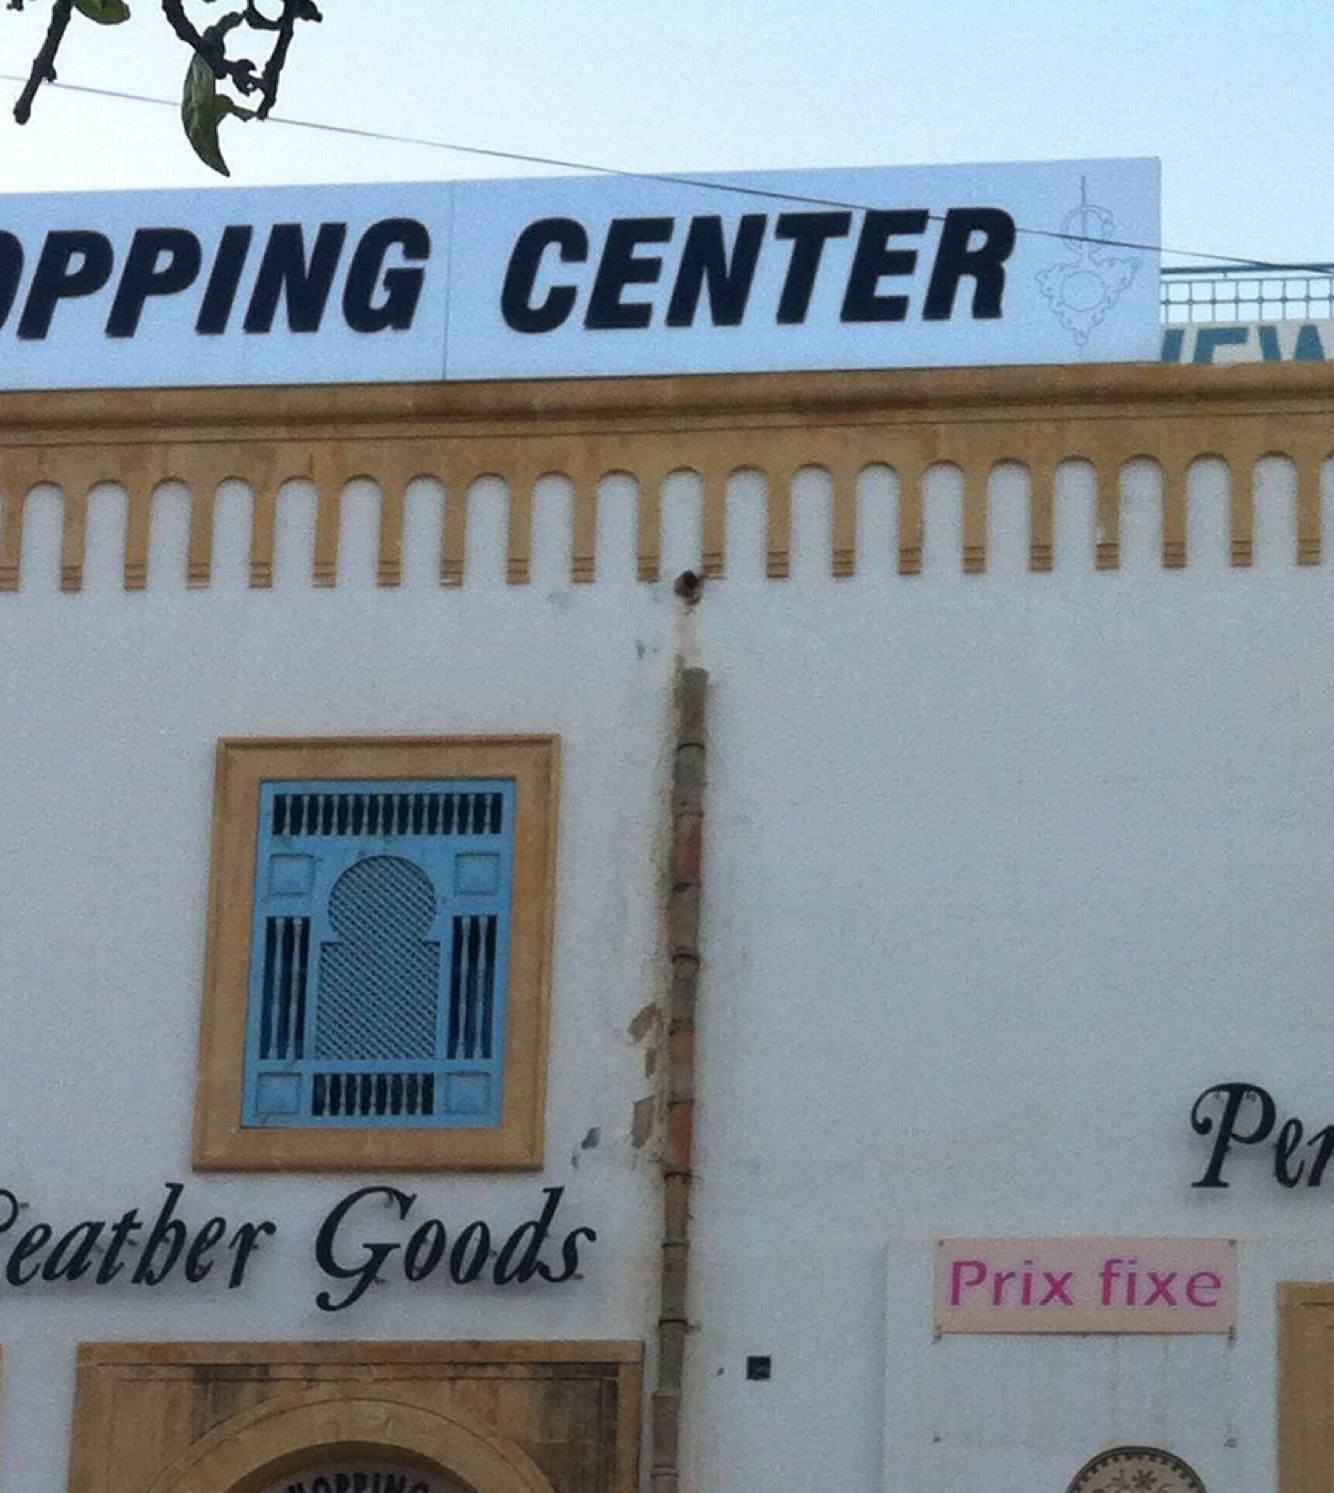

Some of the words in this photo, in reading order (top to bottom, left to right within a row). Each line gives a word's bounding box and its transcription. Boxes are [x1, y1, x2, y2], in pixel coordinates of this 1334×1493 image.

[499, 205, 1017, 336] CENTER
[314, 1185, 598, 1312] Goods
[949, 1259, 1074, 1307] Prix
[1098, 1258, 1223, 1308] fixe
